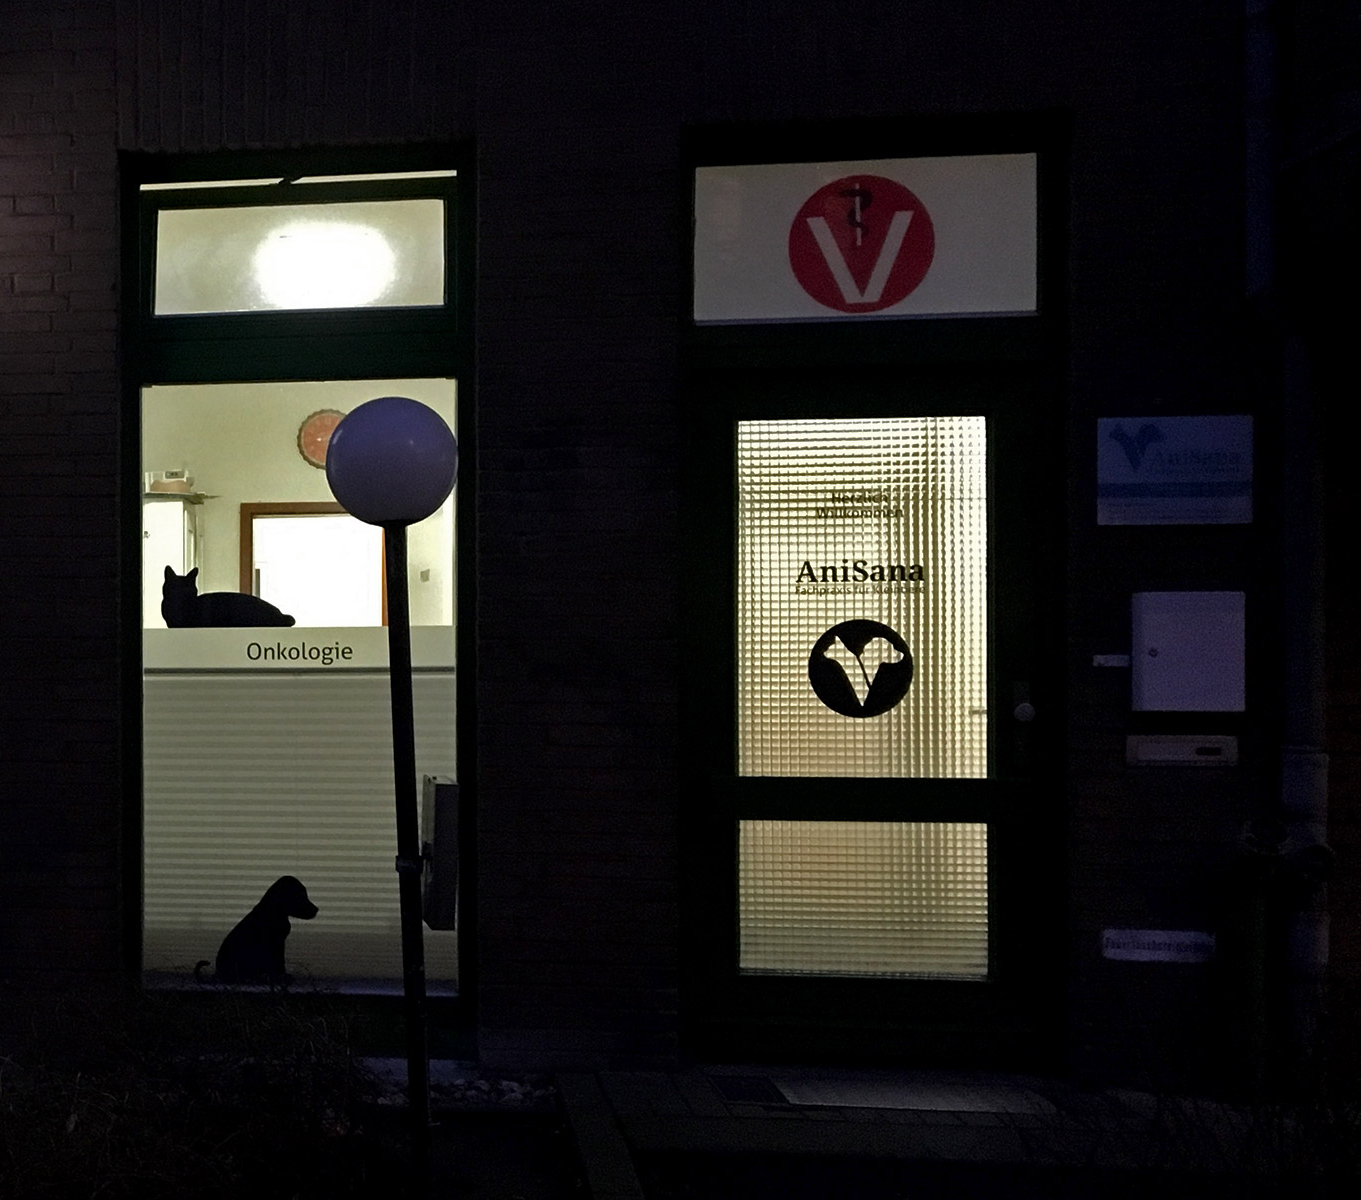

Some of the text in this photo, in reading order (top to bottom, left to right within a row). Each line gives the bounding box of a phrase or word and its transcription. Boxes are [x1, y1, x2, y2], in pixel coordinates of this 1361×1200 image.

[832, 491, 888, 504] Herzlich
[816, 506, 904, 519] Willkommen
[795, 559, 926, 583] AniSana
[795, 585, 851, 597] Fachpraxis
[246, 641, 353, 666] Onkologie
